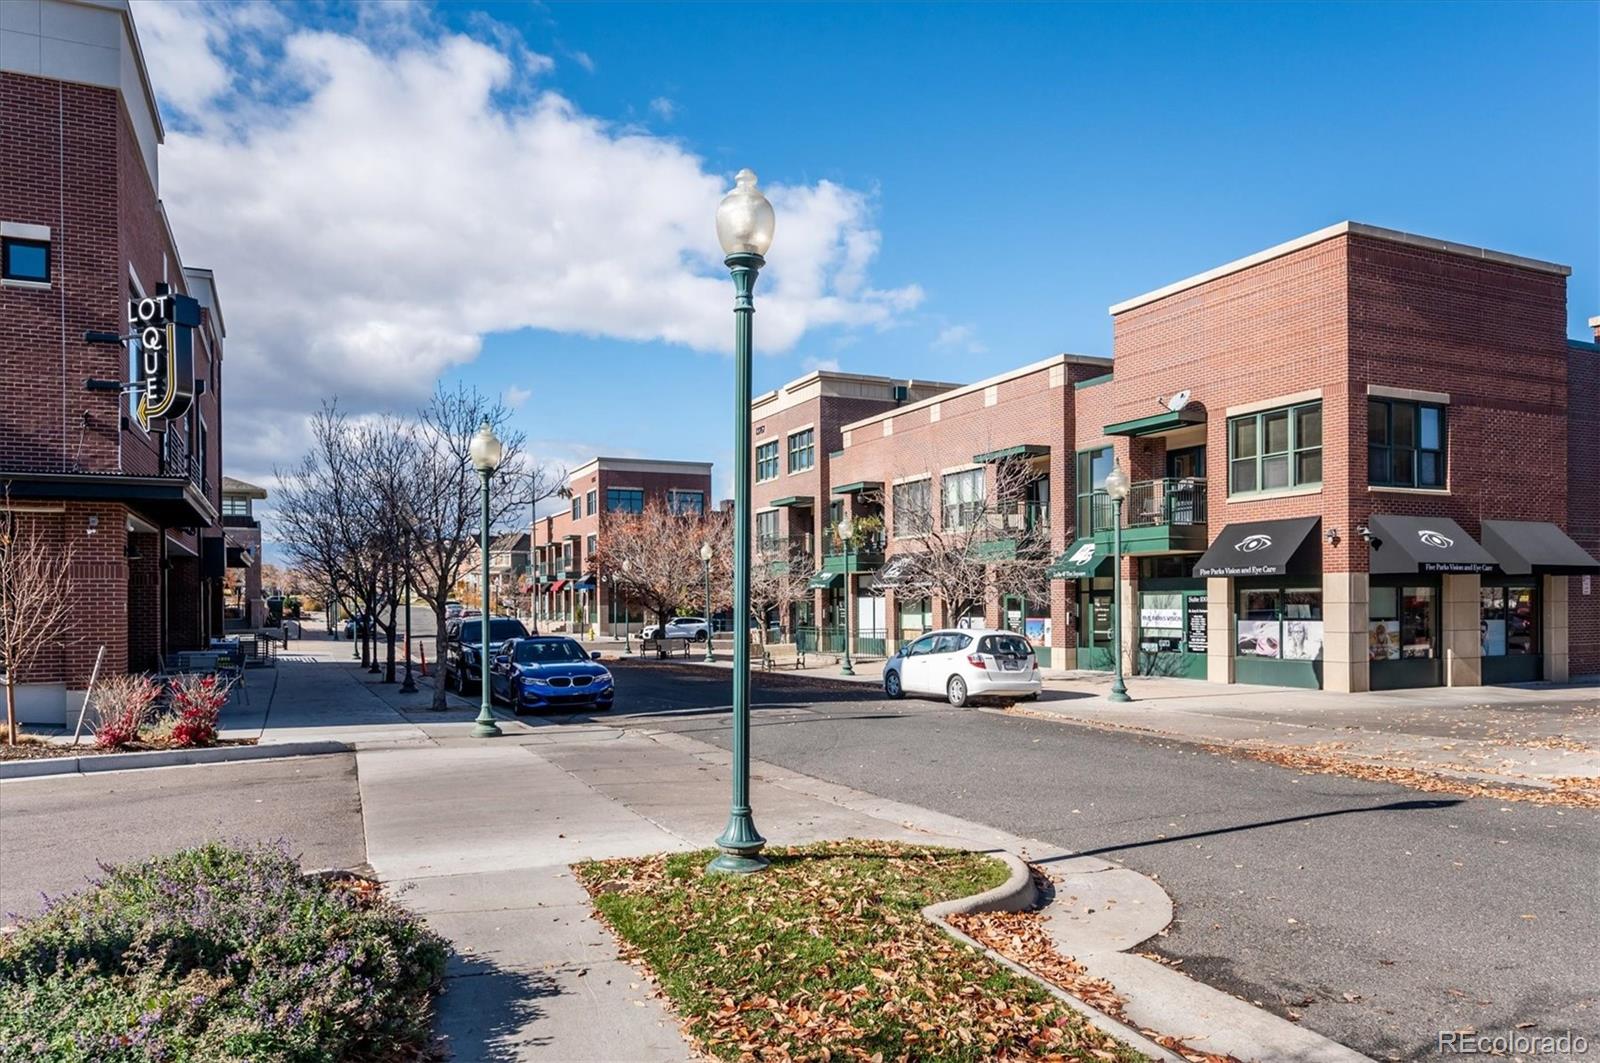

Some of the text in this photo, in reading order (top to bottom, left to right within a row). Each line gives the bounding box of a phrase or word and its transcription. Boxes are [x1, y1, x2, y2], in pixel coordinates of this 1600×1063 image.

[127, 296, 168, 323] LOT
[142, 326, 162, 399] QUE
[1199, 565, 1277, 576] Five Parks Vision and Eye Care
[1425, 563, 1493, 573] Five Parks Vision and Eye Care
